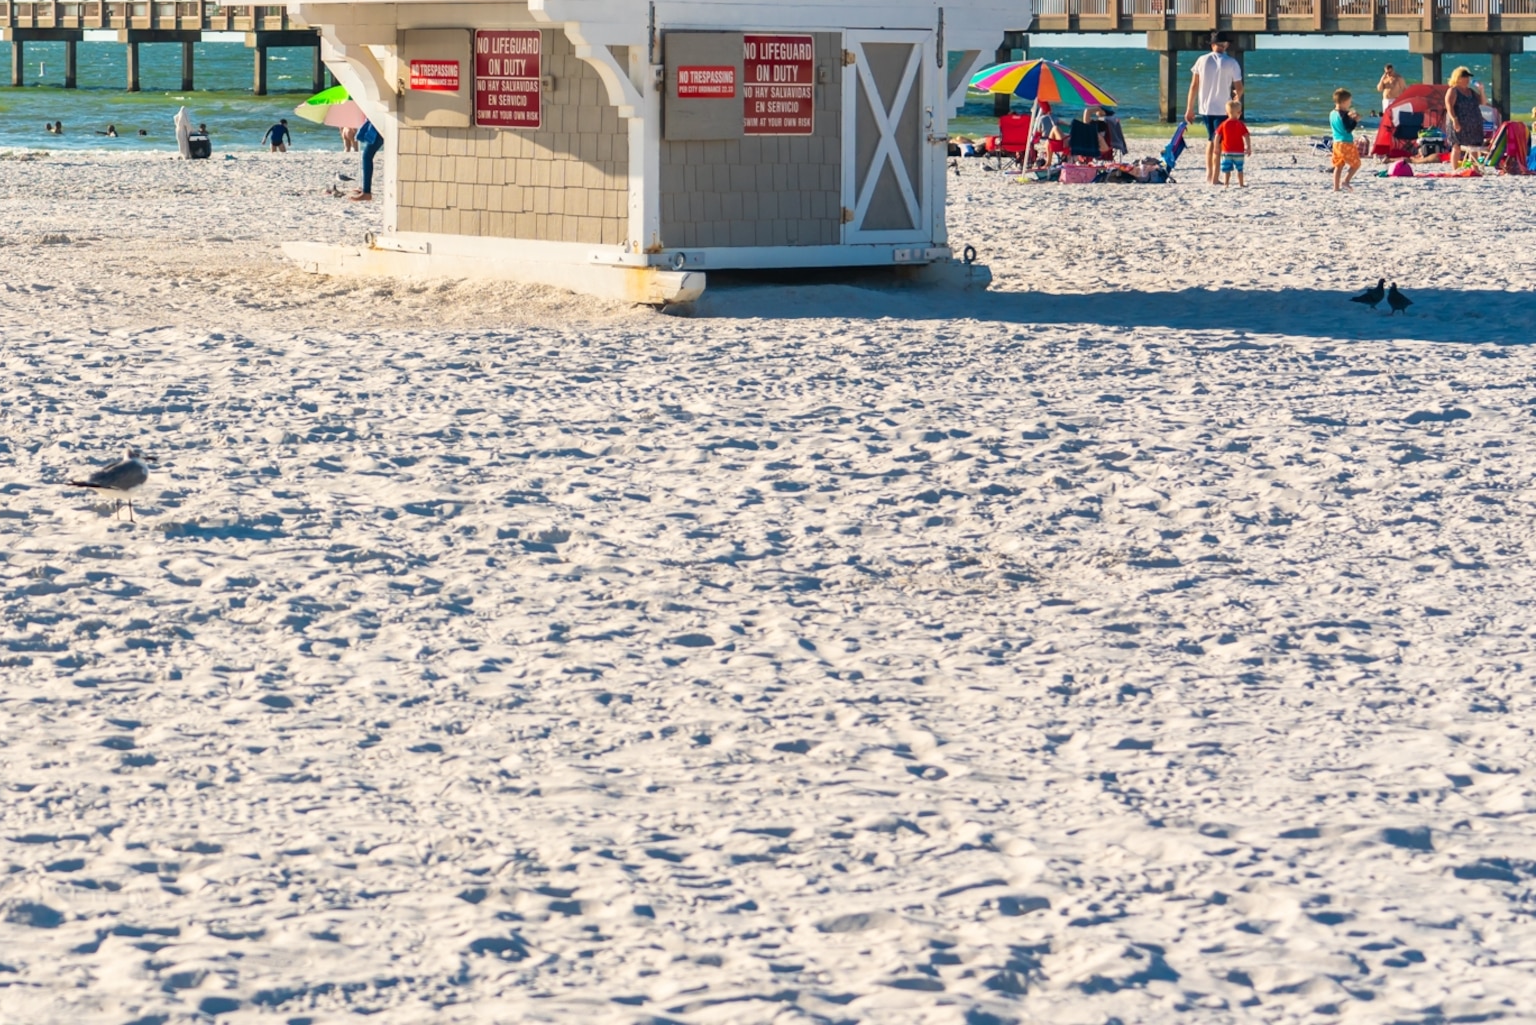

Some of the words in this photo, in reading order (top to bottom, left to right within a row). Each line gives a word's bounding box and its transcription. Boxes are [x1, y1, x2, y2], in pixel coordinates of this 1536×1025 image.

[476, 36, 489, 54] NO
[491, 37, 539, 55] LIFEGUARD
[744, 42, 757, 60] NO
[759, 42, 812, 61] LIFEGUARD
[411, 63, 420, 77] NO
[420, 64, 458, 78] TRESPASSING
[488, 58, 501, 76] ON
[503, 58, 526, 76] DUTY
[756, 64, 770, 82] ON
[773, 64, 799, 82] DUTY
[678, 70, 689, 84] NO
[689, 70, 734, 84] TRESPASSING
[477, 80, 486, 91] NO
[487, 80, 500, 91] HAY
[501, 80, 539, 93] SALVAVIDAS
[678, 85, 688, 94] PER
[688, 85, 698, 94] CITY
[744, 86, 753, 98] NO
[754, 86, 769, 98] HAY
[770, 86, 812, 99] SALVAVIDAS
[488, 94, 497, 106] EN
[498, 94, 527, 107] SERVICIO
[755, 101, 765, 113] EN
[767, 101, 799, 114] SERVICIO
[477, 109, 491, 119] SWIM
[492, 110, 499, 119] AT
[499, 110, 513, 120] YOUR
[513, 111, 526, 121] OWN
[526, 111, 539, 121] RISK
[744, 117, 758, 127] SWIM
[759, 117, 767, 127] AT
[767, 117, 783, 127] YOUR
[783, 117, 797, 128] OWN
[797, 117, 811, 128] RISK
